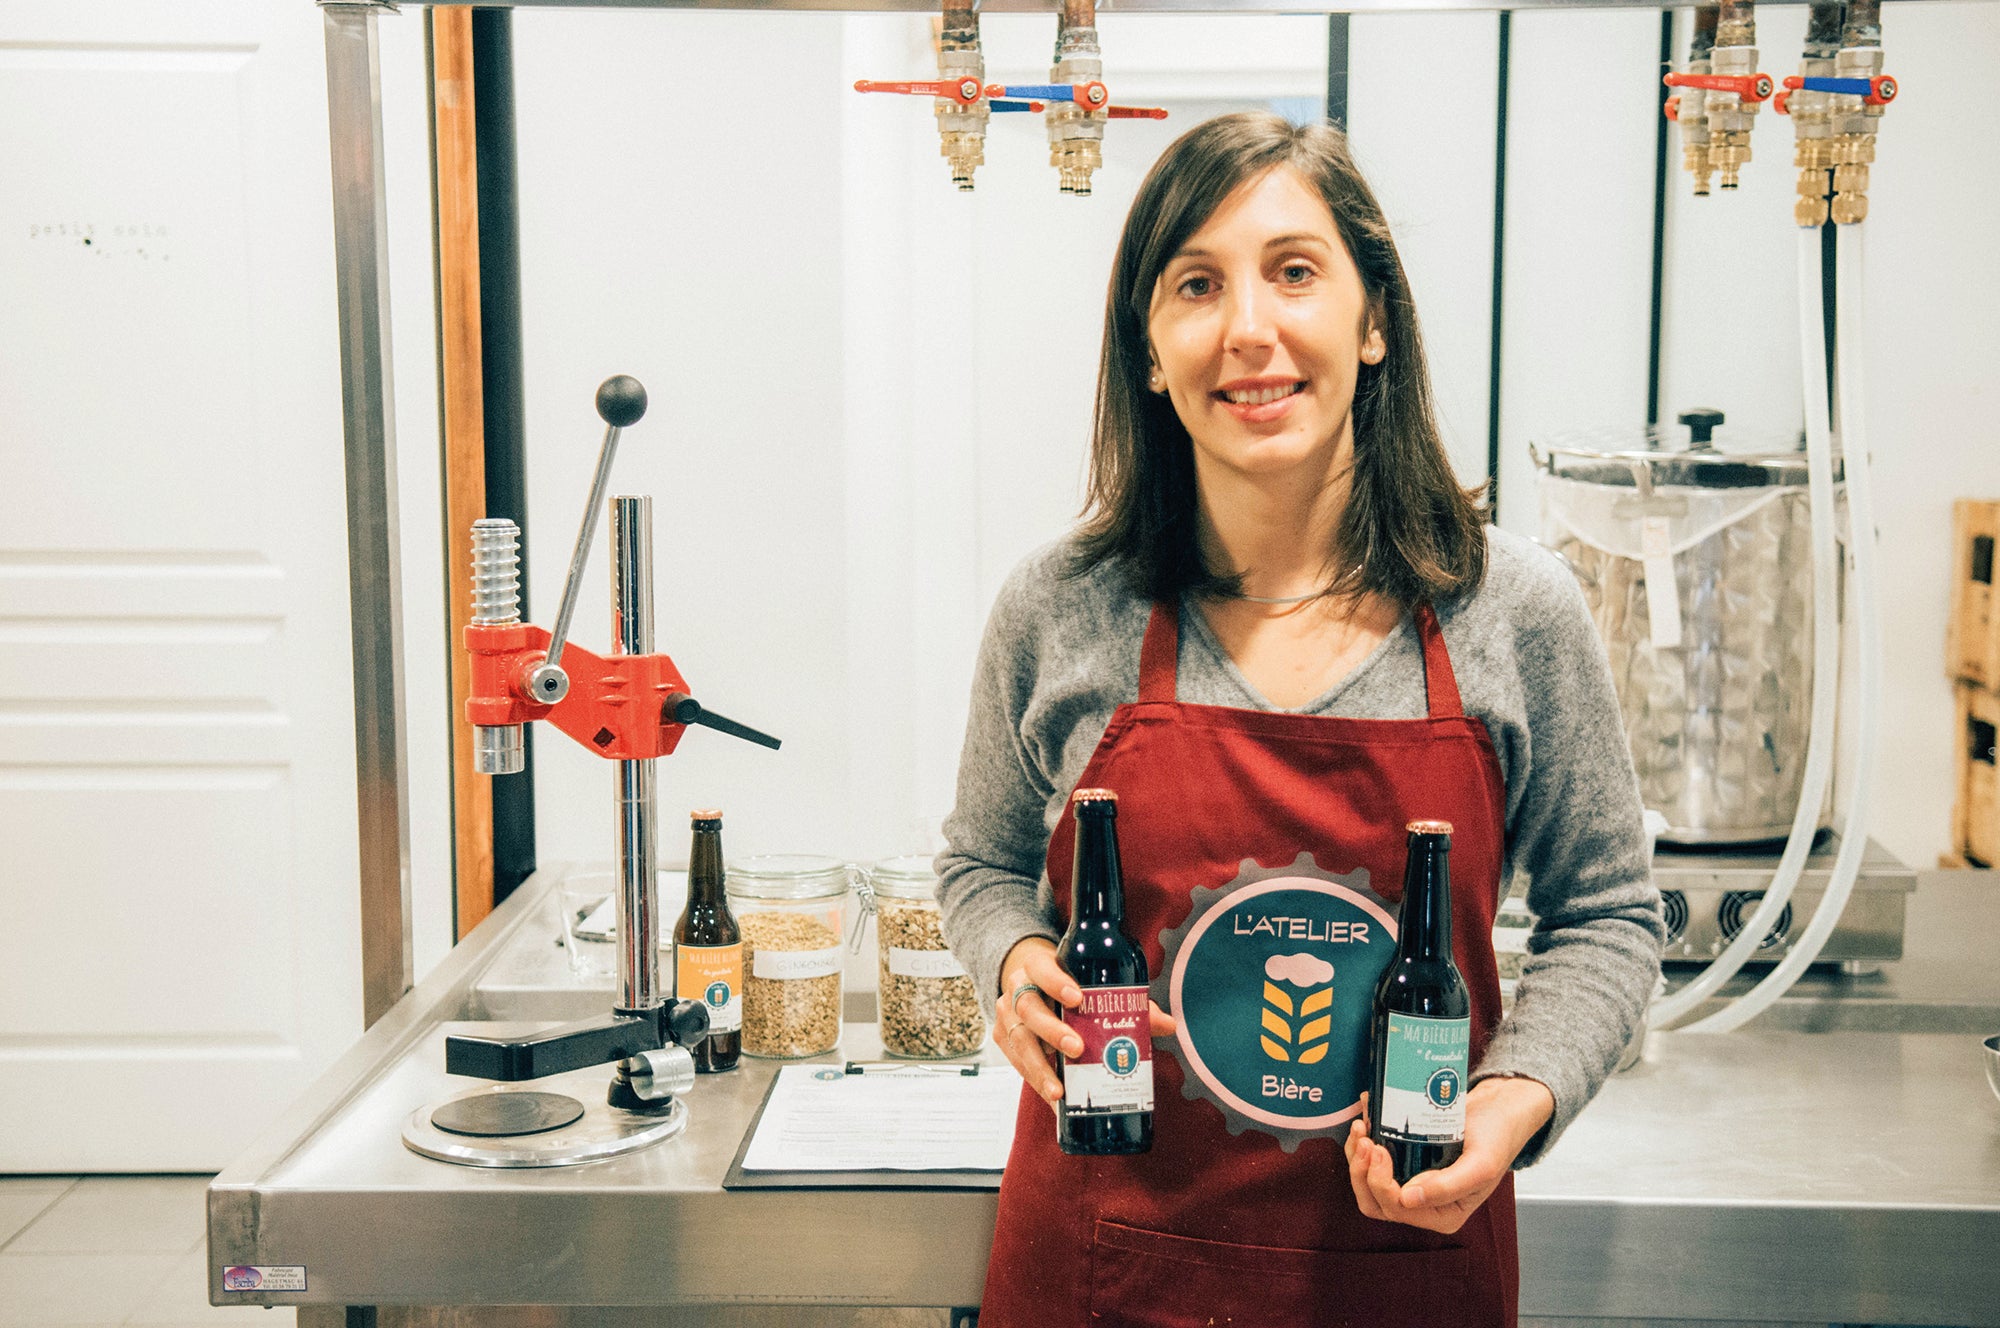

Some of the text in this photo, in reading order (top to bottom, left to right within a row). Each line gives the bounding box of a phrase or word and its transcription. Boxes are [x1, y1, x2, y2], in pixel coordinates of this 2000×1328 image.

[1233, 913, 1370, 944] L'ATELIER
[1079, 995, 1094, 1014] MA
[1096, 991, 1125, 1013] BIÈRE
[1404, 1024, 1420, 1041] MA
[1423, 1024, 1449, 1044] BIÈRE
[1261, 1074, 1323, 1103] Bière
